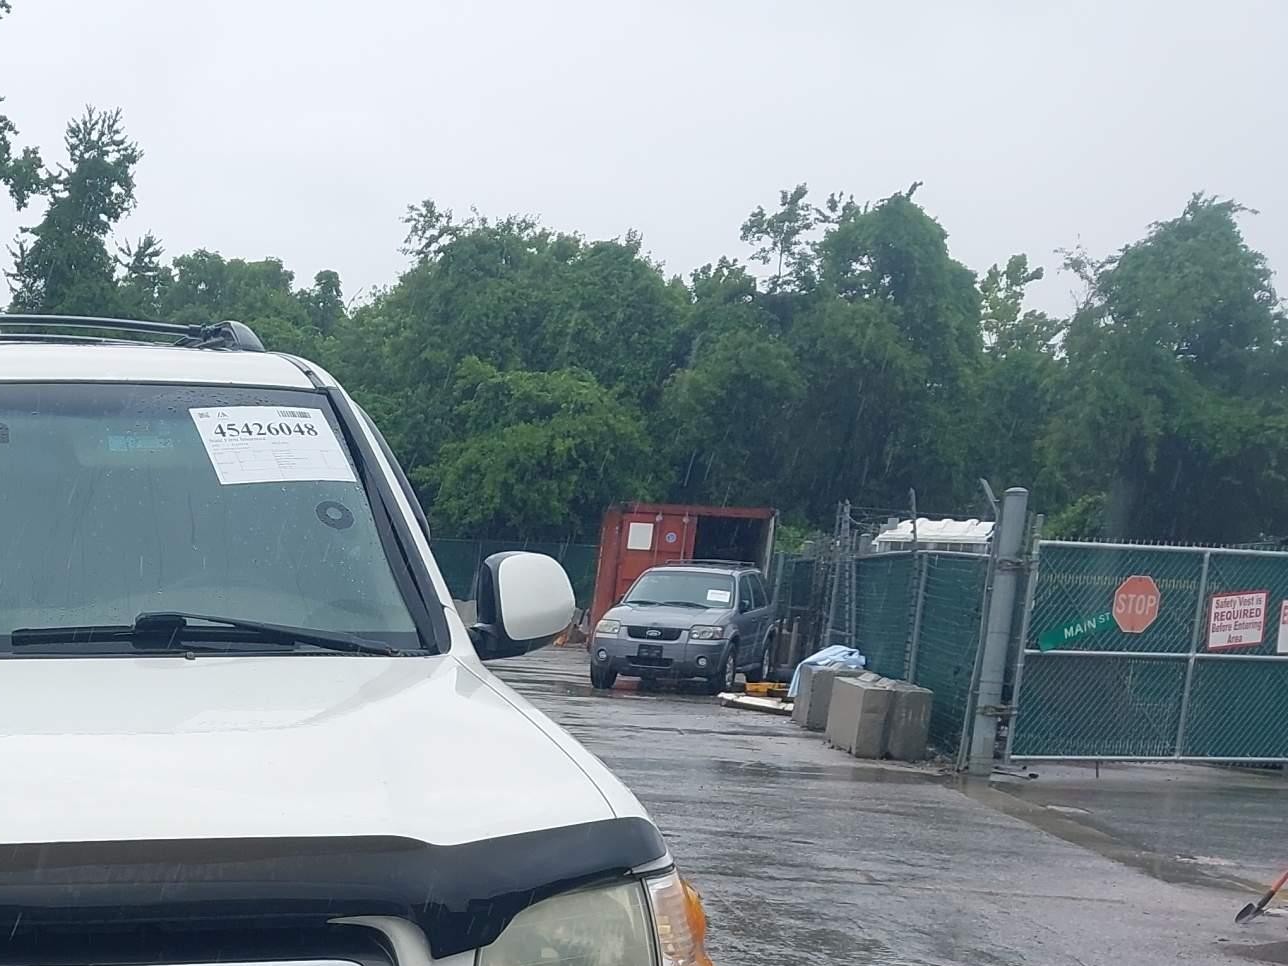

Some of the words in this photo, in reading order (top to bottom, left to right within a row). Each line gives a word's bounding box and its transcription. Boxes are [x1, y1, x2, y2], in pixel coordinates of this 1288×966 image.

[214, 422, 319, 438] 45426048
[1115, 593, 1157, 616] STOP
[1215, 597, 1238, 609] Safety
[1238, 596, 1255, 607] Vest
[1213, 607, 1262, 622] REQUIRED
[1063, 617, 1097, 640] MAIN
[1098, 612, 1111, 624] ST
[1211, 621, 1233, 633] Before
[1233, 620, 1262, 632] Entering
[1227, 633, 1243, 644] Area
